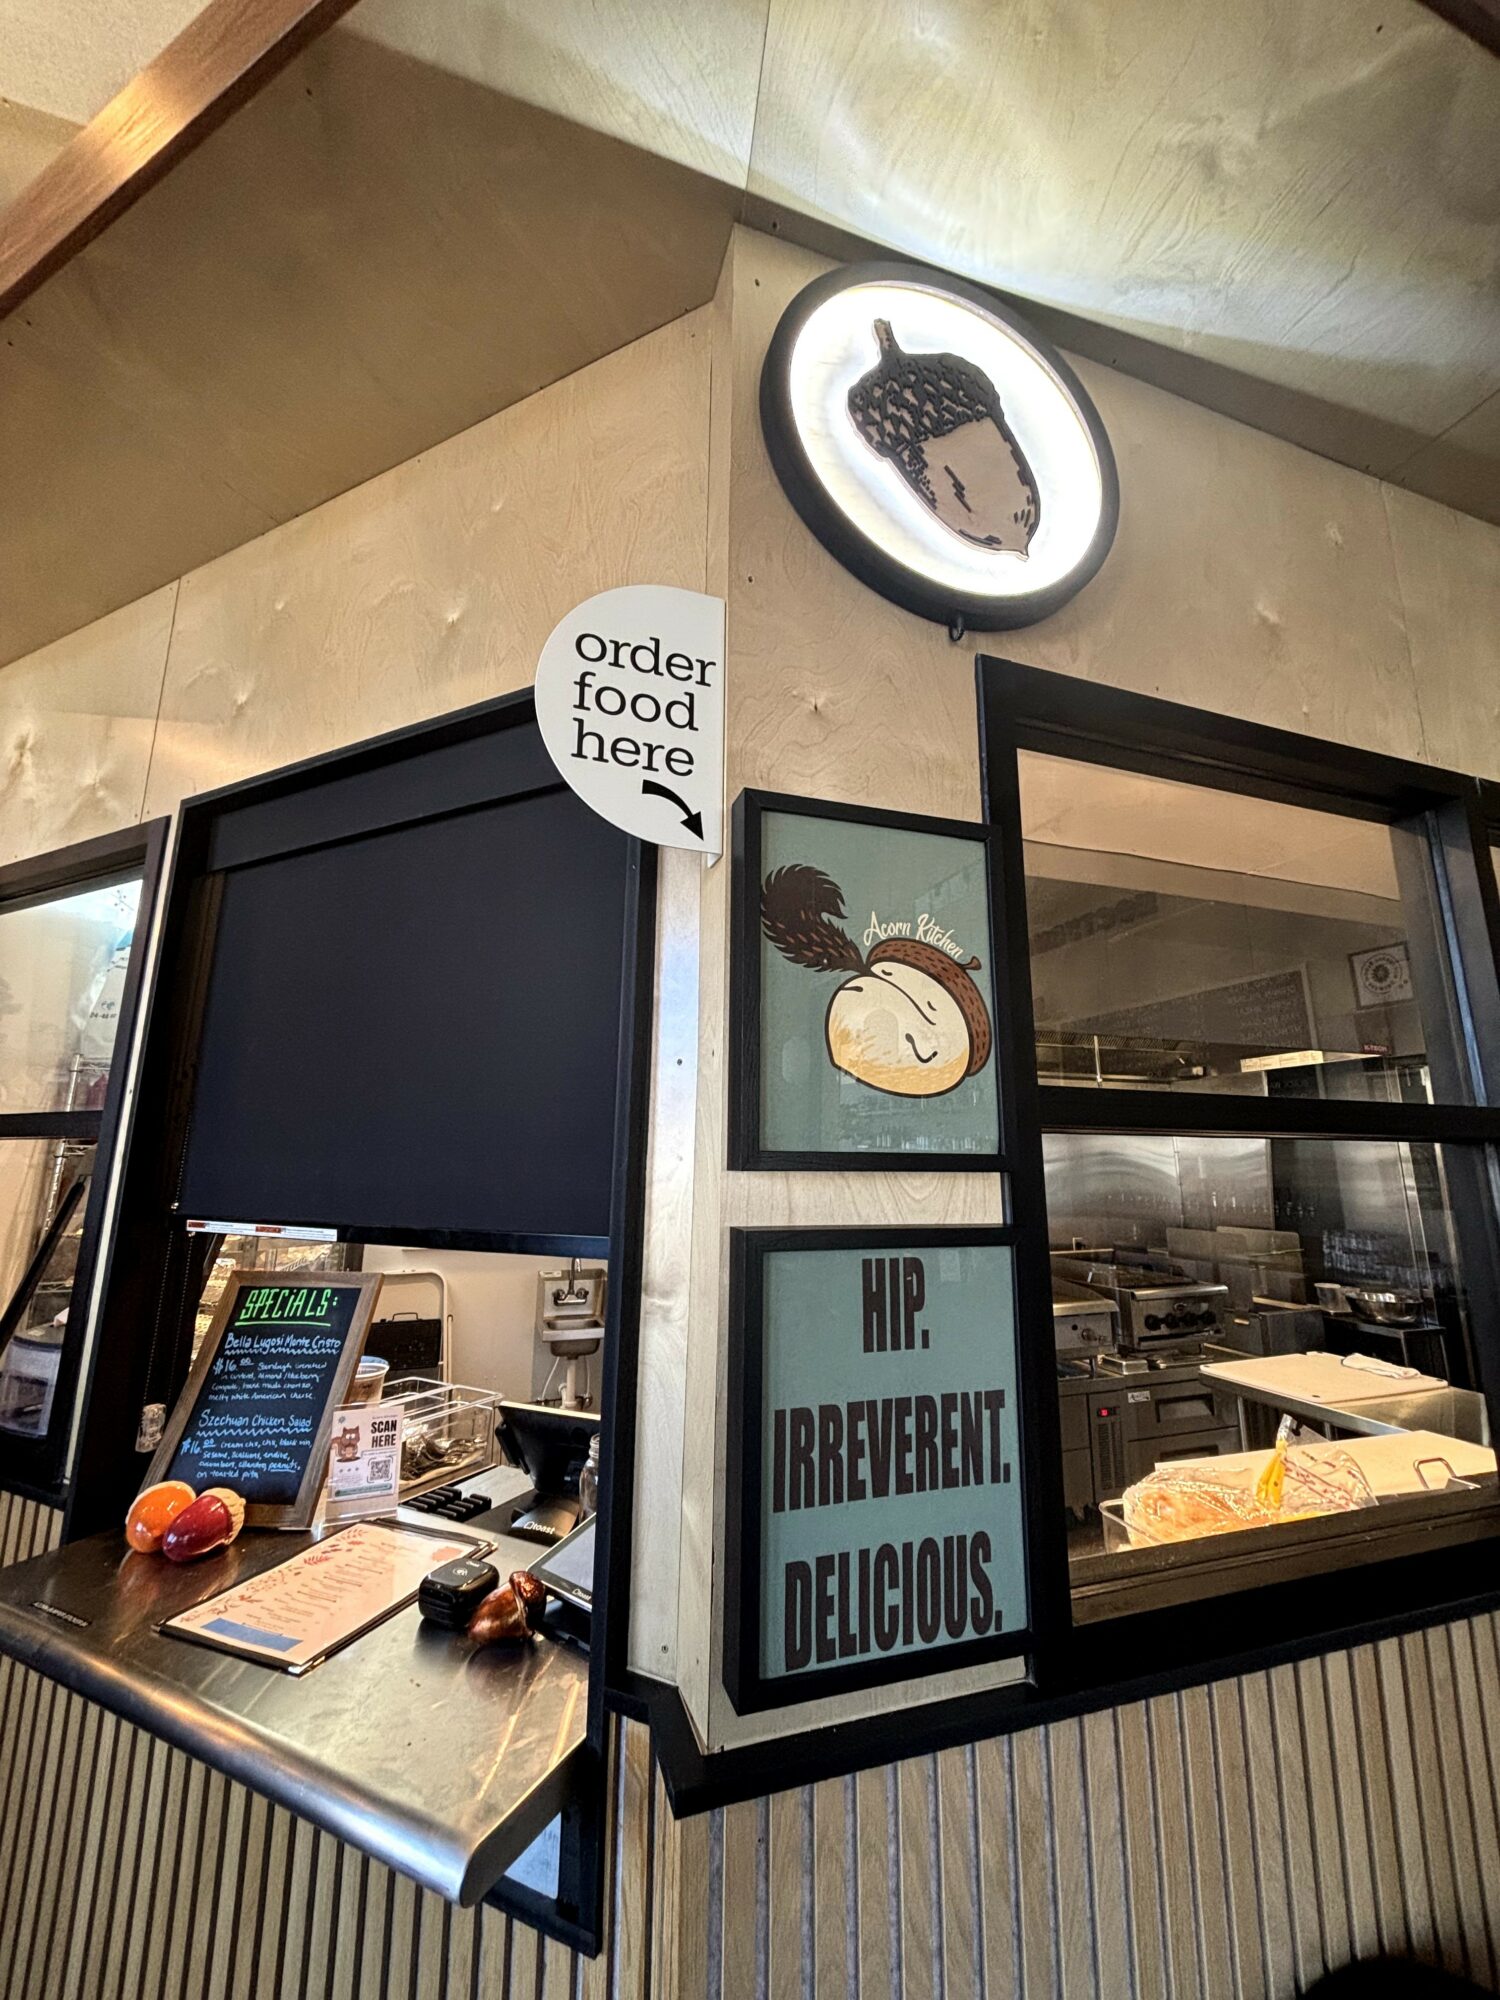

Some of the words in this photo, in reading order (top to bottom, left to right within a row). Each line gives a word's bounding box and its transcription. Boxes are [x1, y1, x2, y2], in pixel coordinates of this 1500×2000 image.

[575, 632, 717, 688] order
[572, 670, 699, 732] food
[570, 716, 695, 777] here
[863, 911, 912, 946] Acorn
[915, 913, 964, 960] Kitchen
[861, 1256, 931, 1354] HIP.
[224, 1332, 252, 1349] Bella
[253, 1334, 284, 1354] Lugosi
[284, 1334, 310, 1348] Monte
[311, 1335, 341, 1348] Cristo
[199, 1408, 250, 1428] Szechuan
[251, 1414, 285, 1427] Chicken
[287, 1414, 312, 1428] Salad
[370, 1420, 398, 1434] SCAN
[371, 1434, 397, 1448] HERE
[772, 1388, 1012, 1514] IRREVERENT.
[533, 1522, 556, 1535] toast
[784, 1530, 1003, 1673] DELICIOUS.
